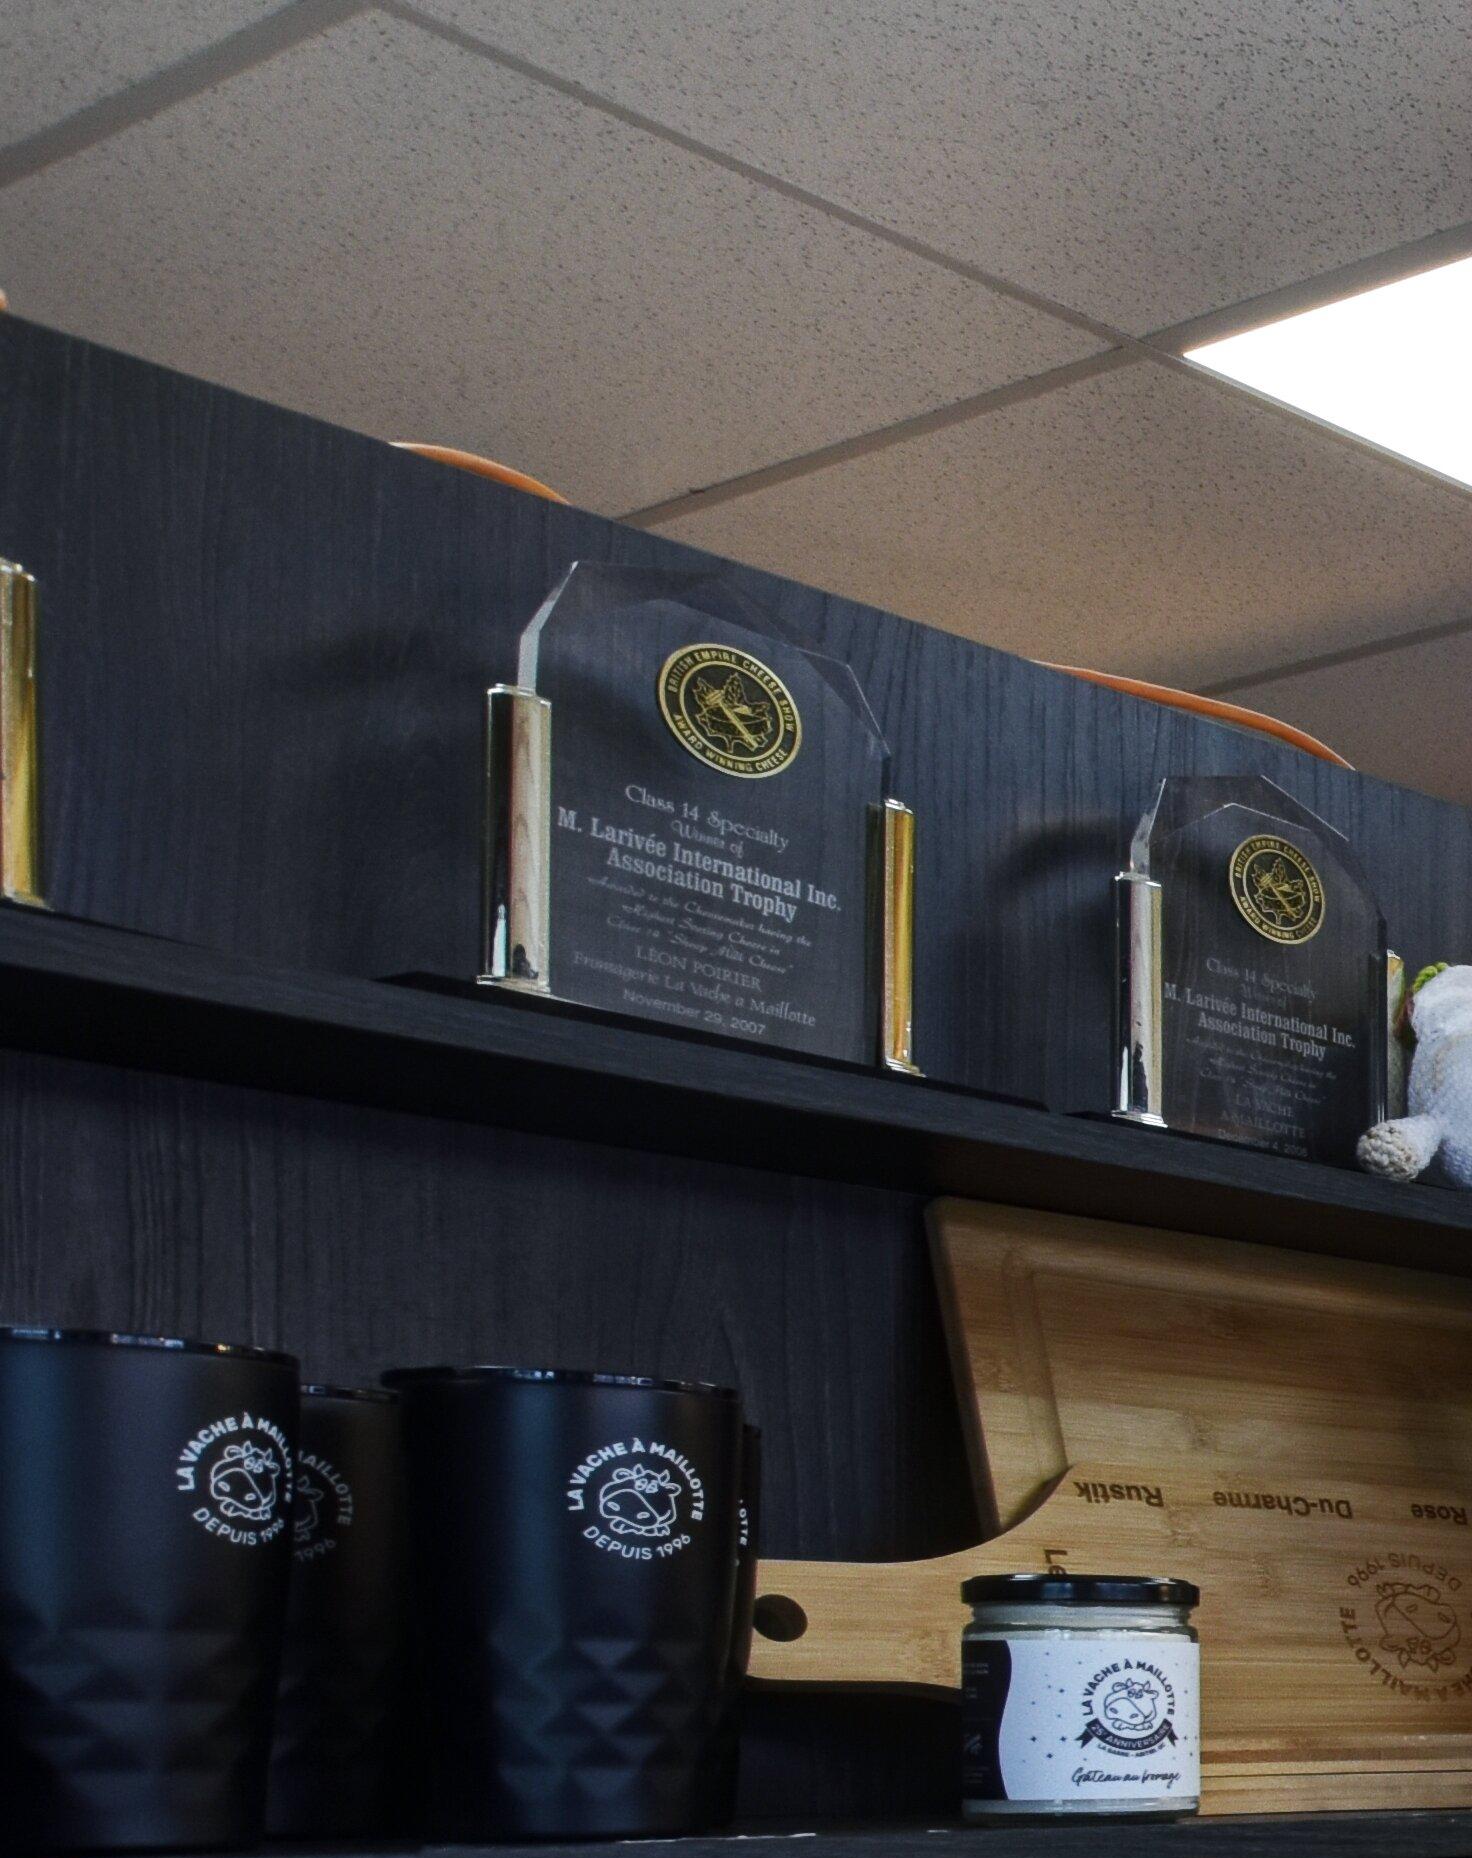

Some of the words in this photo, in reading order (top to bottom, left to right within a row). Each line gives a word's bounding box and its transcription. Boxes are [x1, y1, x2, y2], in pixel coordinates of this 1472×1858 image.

[666, 655, 695, 693] BRITISH
[699, 648, 737, 666] EMPIRE
[742, 659, 783, 698] CHEESE
[780, 699, 796, 733] SHOW
[674, 713, 704, 750] AWARD
[704, 747, 752, 774] WINNING
[755, 747, 788, 774] CHEESE
[624, 784, 676, 814] Class
[681, 801, 700, 821] 14
[706, 810, 790, 855] Specialty
[557, 806, 585, 833] M.
[590, 816, 667, 858] Larivée
[674, 841, 801, 899] International
[807, 884, 842, 912] Inc.
[606, 848, 723, 898] Association
[730, 884, 798, 924] Trophy
[1186, 988, 1238, 1017] Larivée
[1241, 1003, 1329, 1042] International
[1332, 1027, 1356, 1049] Inc.
[1198, 1011, 1276, 1046] Association
[1281, 1033, 1327, 1061] Trophy
[180, 1416, 239, 1463] VACHE
[241, 1411, 254, 1429] À
[257, 1417, 293, 1503] MAILLOTTE
[570, 1442, 628, 1485] VACHE
[631, 1437, 646, 1454] À
[176, 1466, 195, 1491] LA
[567, 1489, 585, 1511] LA
[649, 1441, 704, 1521] MAILLOTTE
[1073, 1480, 1164, 1508] Rustik
[1212, 1489, 1353, 1520] Du-Charme
[1410, 1502, 1468, 1526] Rose
[193, 1507, 257, 1546] DEPUIS
[260, 1518, 285, 1543] 1996
[583, 1525, 653, 1560] DEPUIS
[656, 1534, 691, 1558] 1996
[1347, 1555, 1386, 1590] 1996
[1389, 1552, 1462, 1592] DEPUIS
[1124, 1659, 1133, 1670] À
[1339, 1605, 1432, 1698] MAILLOTTE
[1083, 1663, 1120, 1697] VACHE
[1136, 1661, 1175, 1716] MAILLOTTE
[1081, 1700, 1094, 1716] LA
